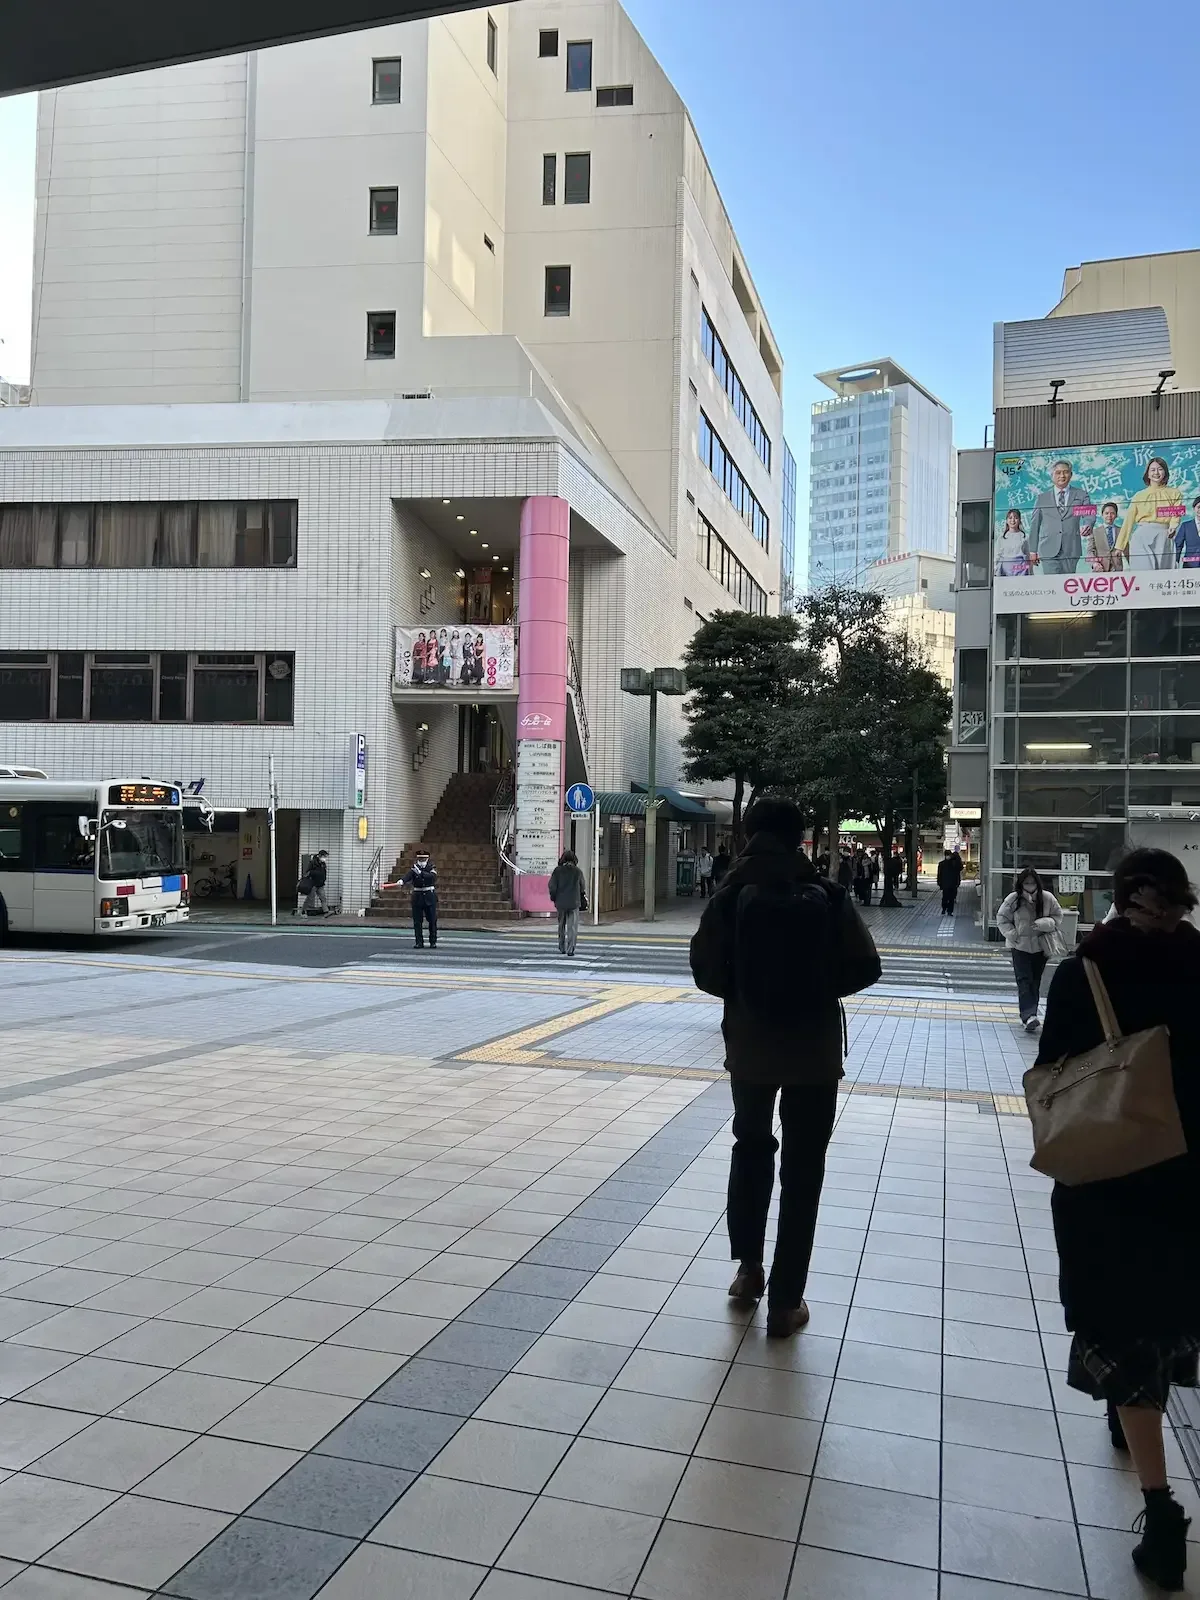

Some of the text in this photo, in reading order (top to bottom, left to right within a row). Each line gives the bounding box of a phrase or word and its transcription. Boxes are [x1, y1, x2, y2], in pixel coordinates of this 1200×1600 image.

[1070, 594, 1119, 607] しずおか
[838, 835, 857, 844] KFC
